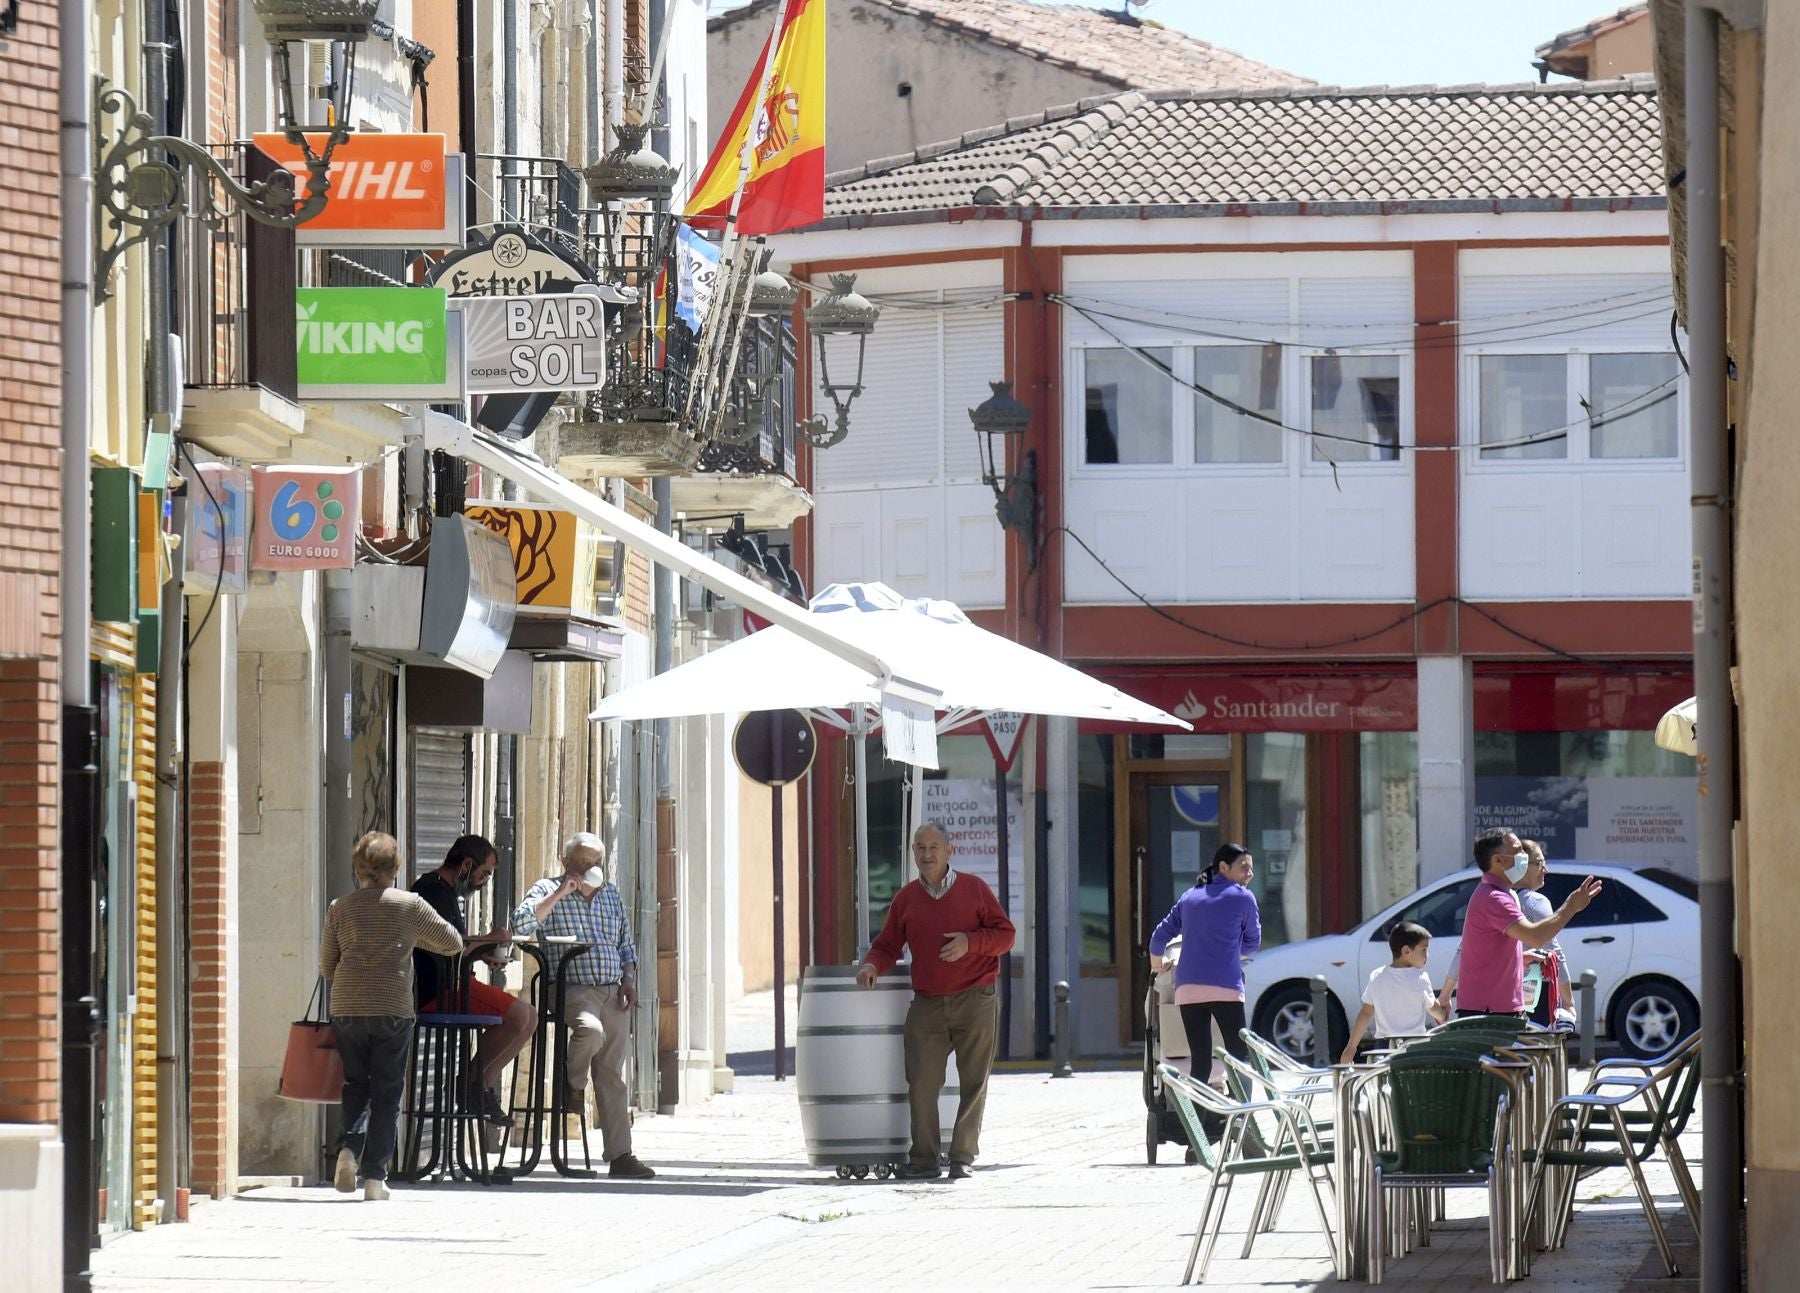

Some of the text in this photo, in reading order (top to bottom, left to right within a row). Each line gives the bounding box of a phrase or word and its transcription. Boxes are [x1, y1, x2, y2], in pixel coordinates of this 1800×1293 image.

[506, 298, 598, 341] BAR
[509, 343, 598, 386] SOL
[471, 367, 507, 378] copas
[269, 544, 339, 559] EURO 6000
[1213, 693, 1340, 718] Santander
[993, 722, 1016, 734] PASO
[927, 784, 949, 797] ¿Tu
[927, 798, 978, 814] negocio
[1493, 805, 1538, 815] ALGUNOS
[958, 816, 966, 826] a
[969, 815, 1016, 829] pruea
[1617, 819, 1628, 827] EN
[1629, 819, 1638, 827] EL
[1639, 819, 1684, 827] SANTANDER
[1543, 827, 1556, 836] DE
